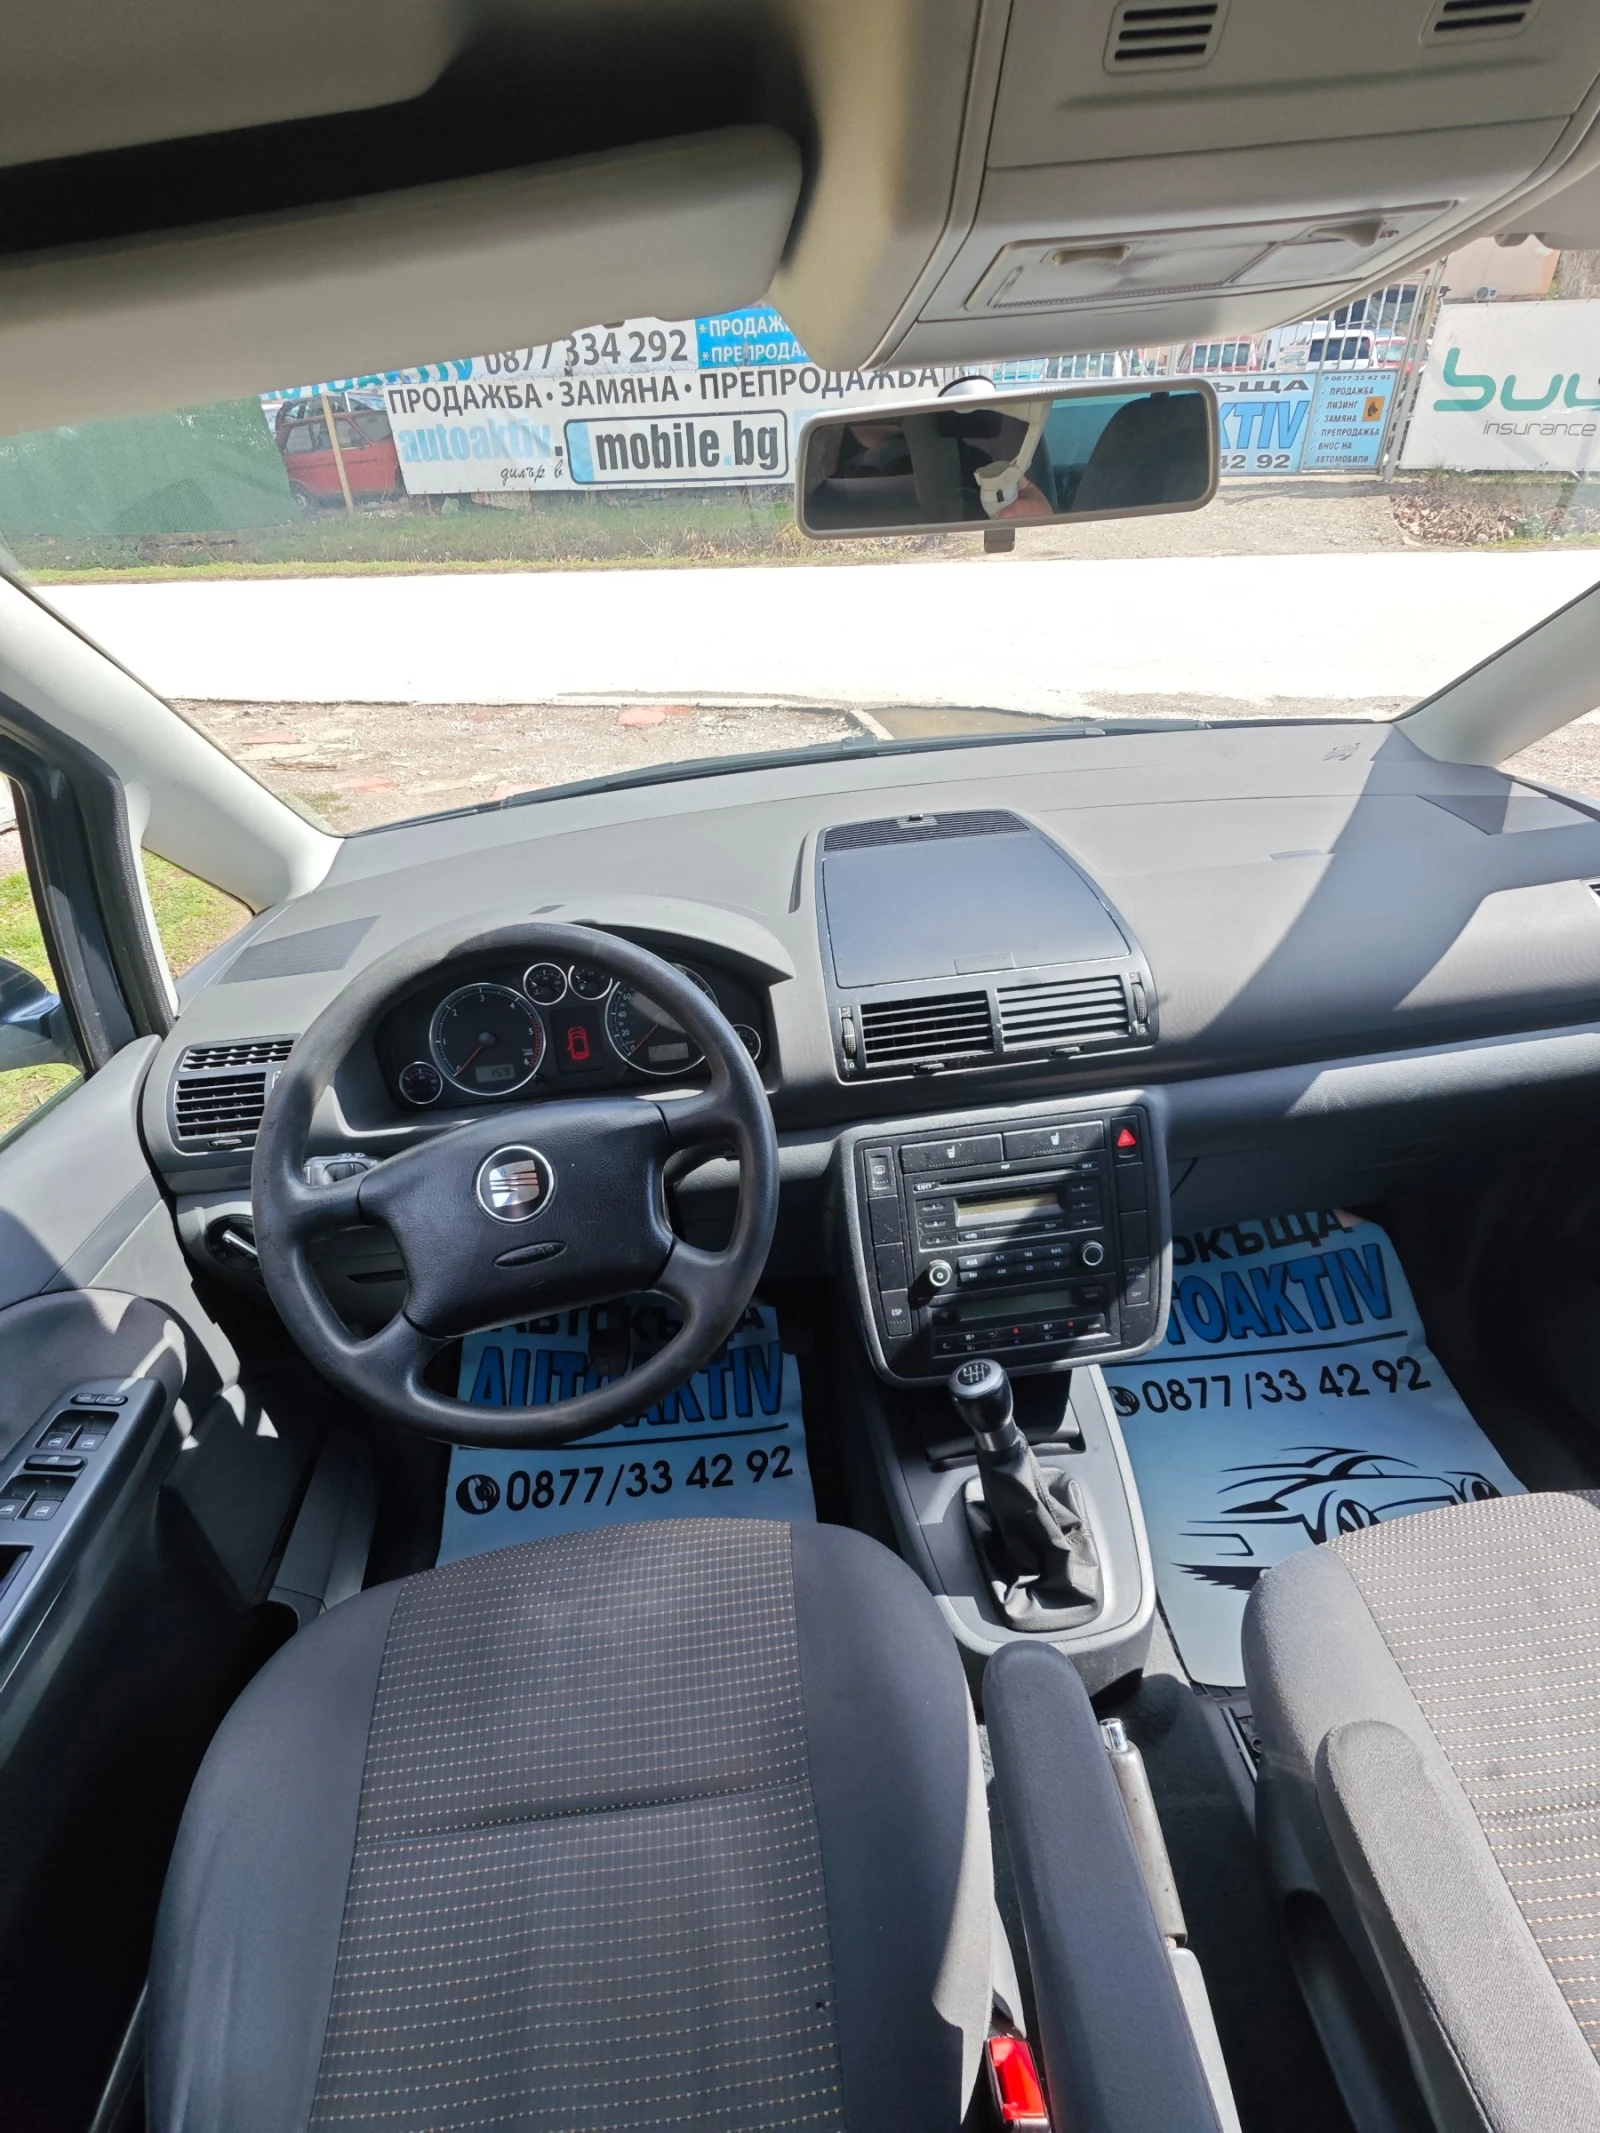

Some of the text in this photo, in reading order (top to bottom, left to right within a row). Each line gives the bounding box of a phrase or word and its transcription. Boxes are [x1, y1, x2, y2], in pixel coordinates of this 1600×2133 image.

[709, 316, 790, 338] ПРОДАЖ
[565, 332, 620, 366] 334
[628, 329, 688, 364] 292
[711, 342, 807, 363] ПРЕПРОДА
[388, 366, 939, 417] ПРОДАЖБА ЗАМЯНА ПРЕПРОДАЖБА
[1329, 387, 1375, 396] ПРОДАЖБА
[1326, 400, 1359, 410] ЛИЗИНГ
[1323, 415, 1357, 423] ЗАМЯНА
[1321, 427, 1380, 437] ПРЕПРОДАЖБА
[1482, 420, 1597, 437] insurance
[595, 420, 779, 470] mobile.bg
[1318, 442, 1352, 450] ВНОС НА
[1256, 454, 1291, 470] 92
[1315, 455, 1369, 464] АВТОМОБИЛИ
[890, 1308, 903, 1317] ESP
[1142, 1356, 1431, 1413] 0877/33 42 92
[506, 1446, 793, 1511] 0877/33 42 92
